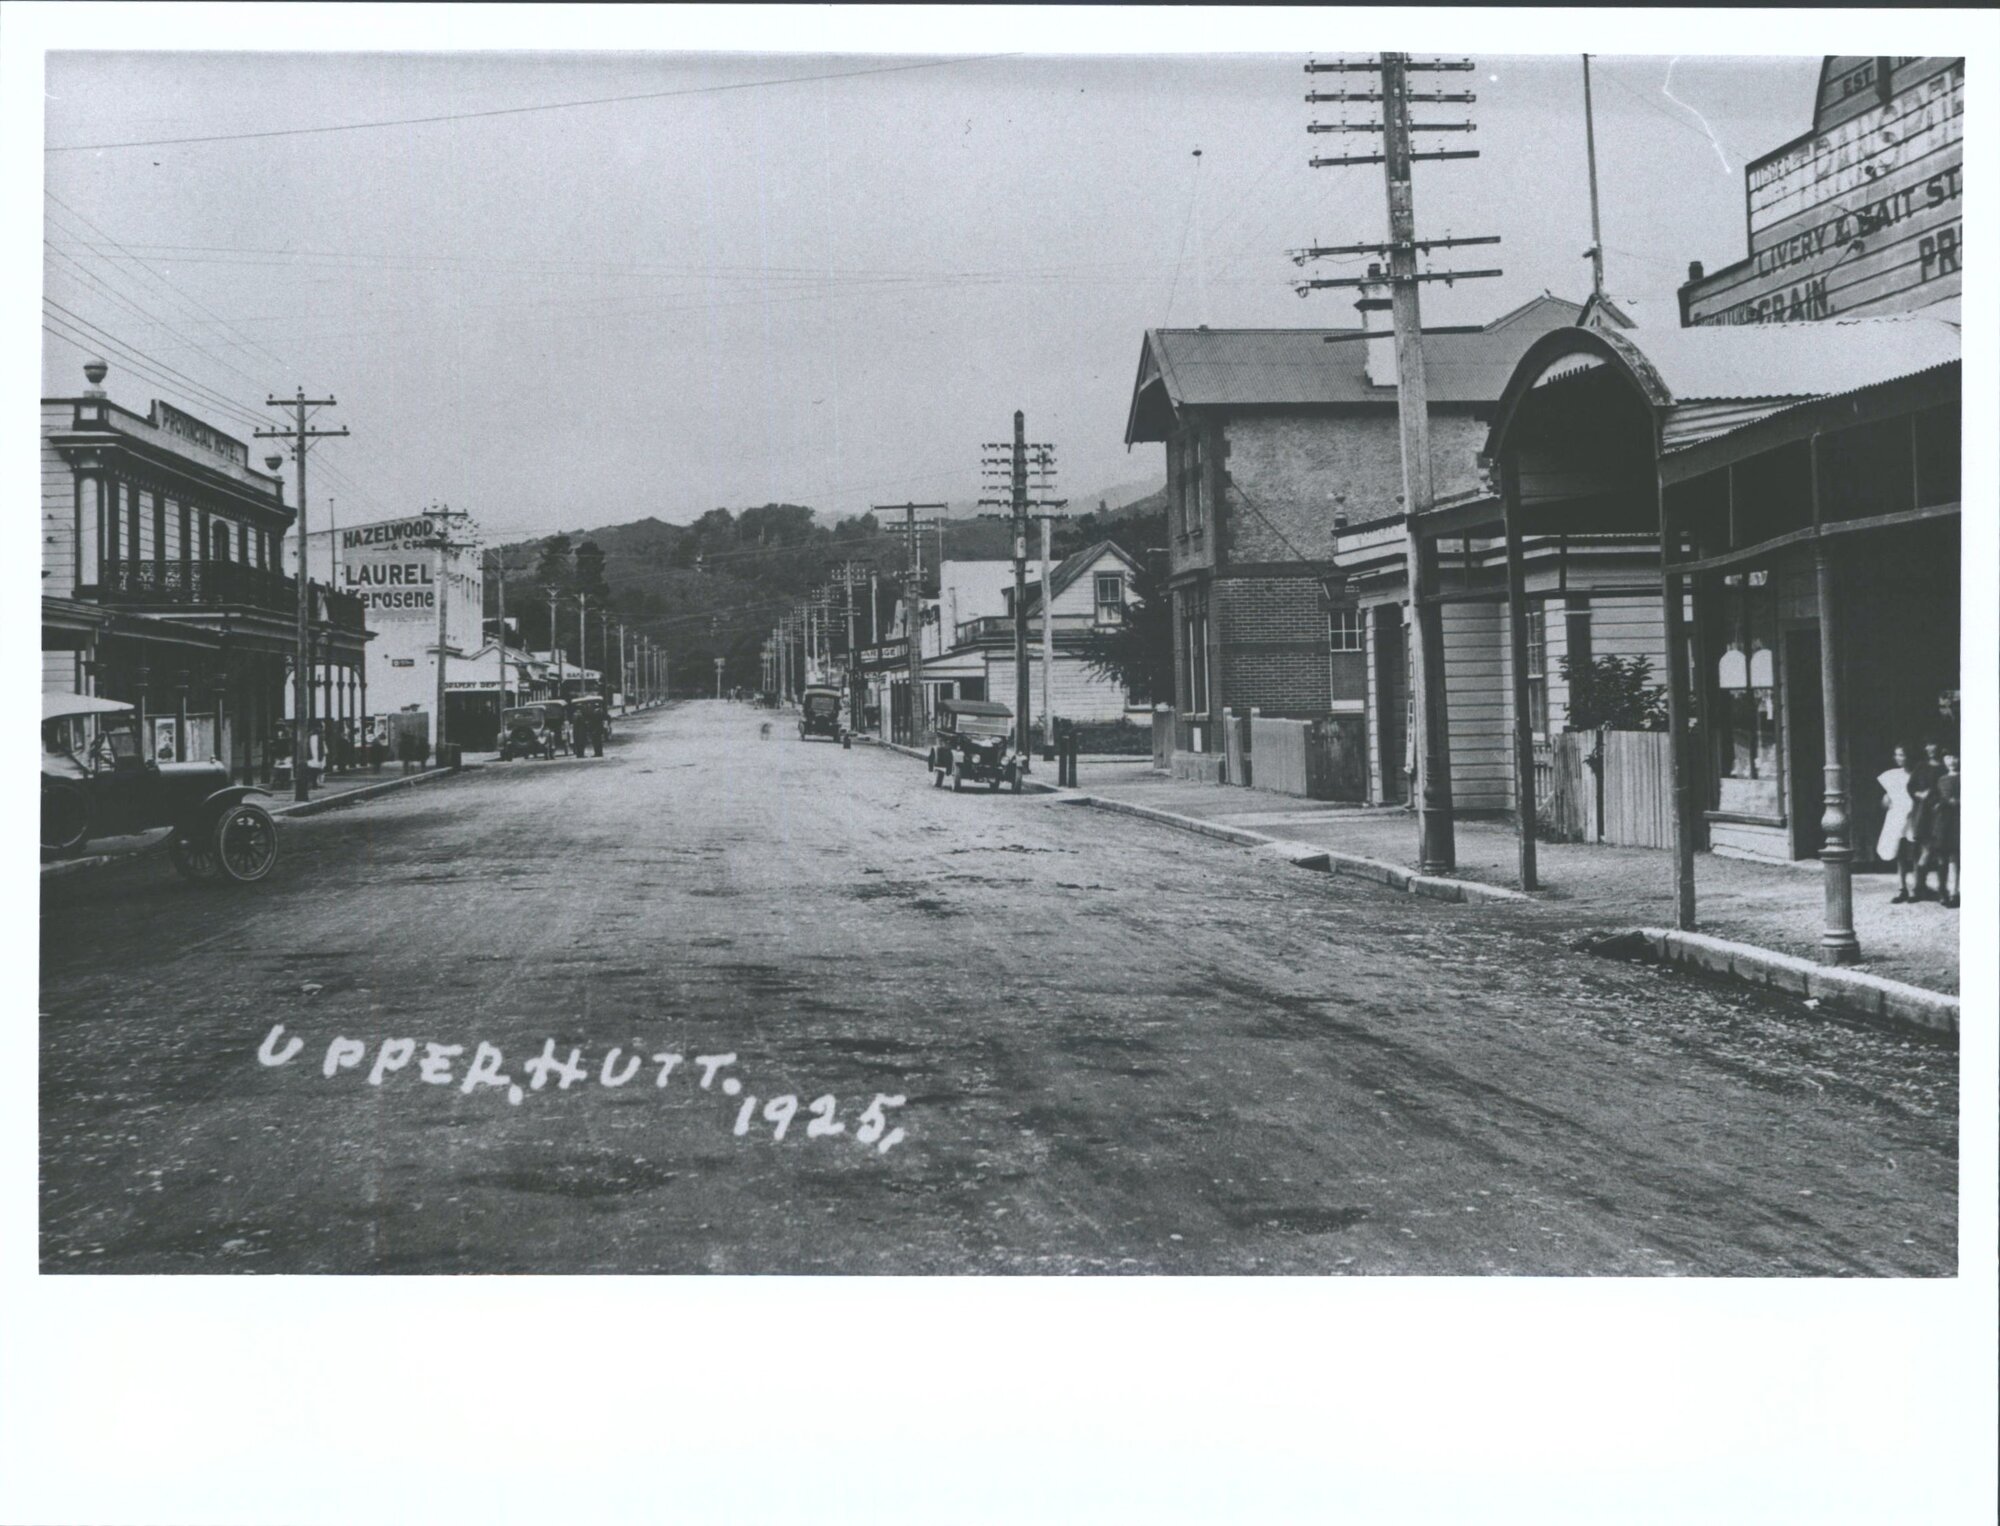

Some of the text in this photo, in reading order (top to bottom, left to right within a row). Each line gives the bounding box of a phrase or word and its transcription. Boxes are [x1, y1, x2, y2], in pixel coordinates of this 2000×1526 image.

[1757, 222, 1827, 278] LIVERY
[1918, 222, 1963, 284] PR
[162, 406, 240, 462] PROVINCIAL HOTEL
[343, 520, 433, 549] HAZELWOOD
[345, 563, 433, 586] LAUREL
